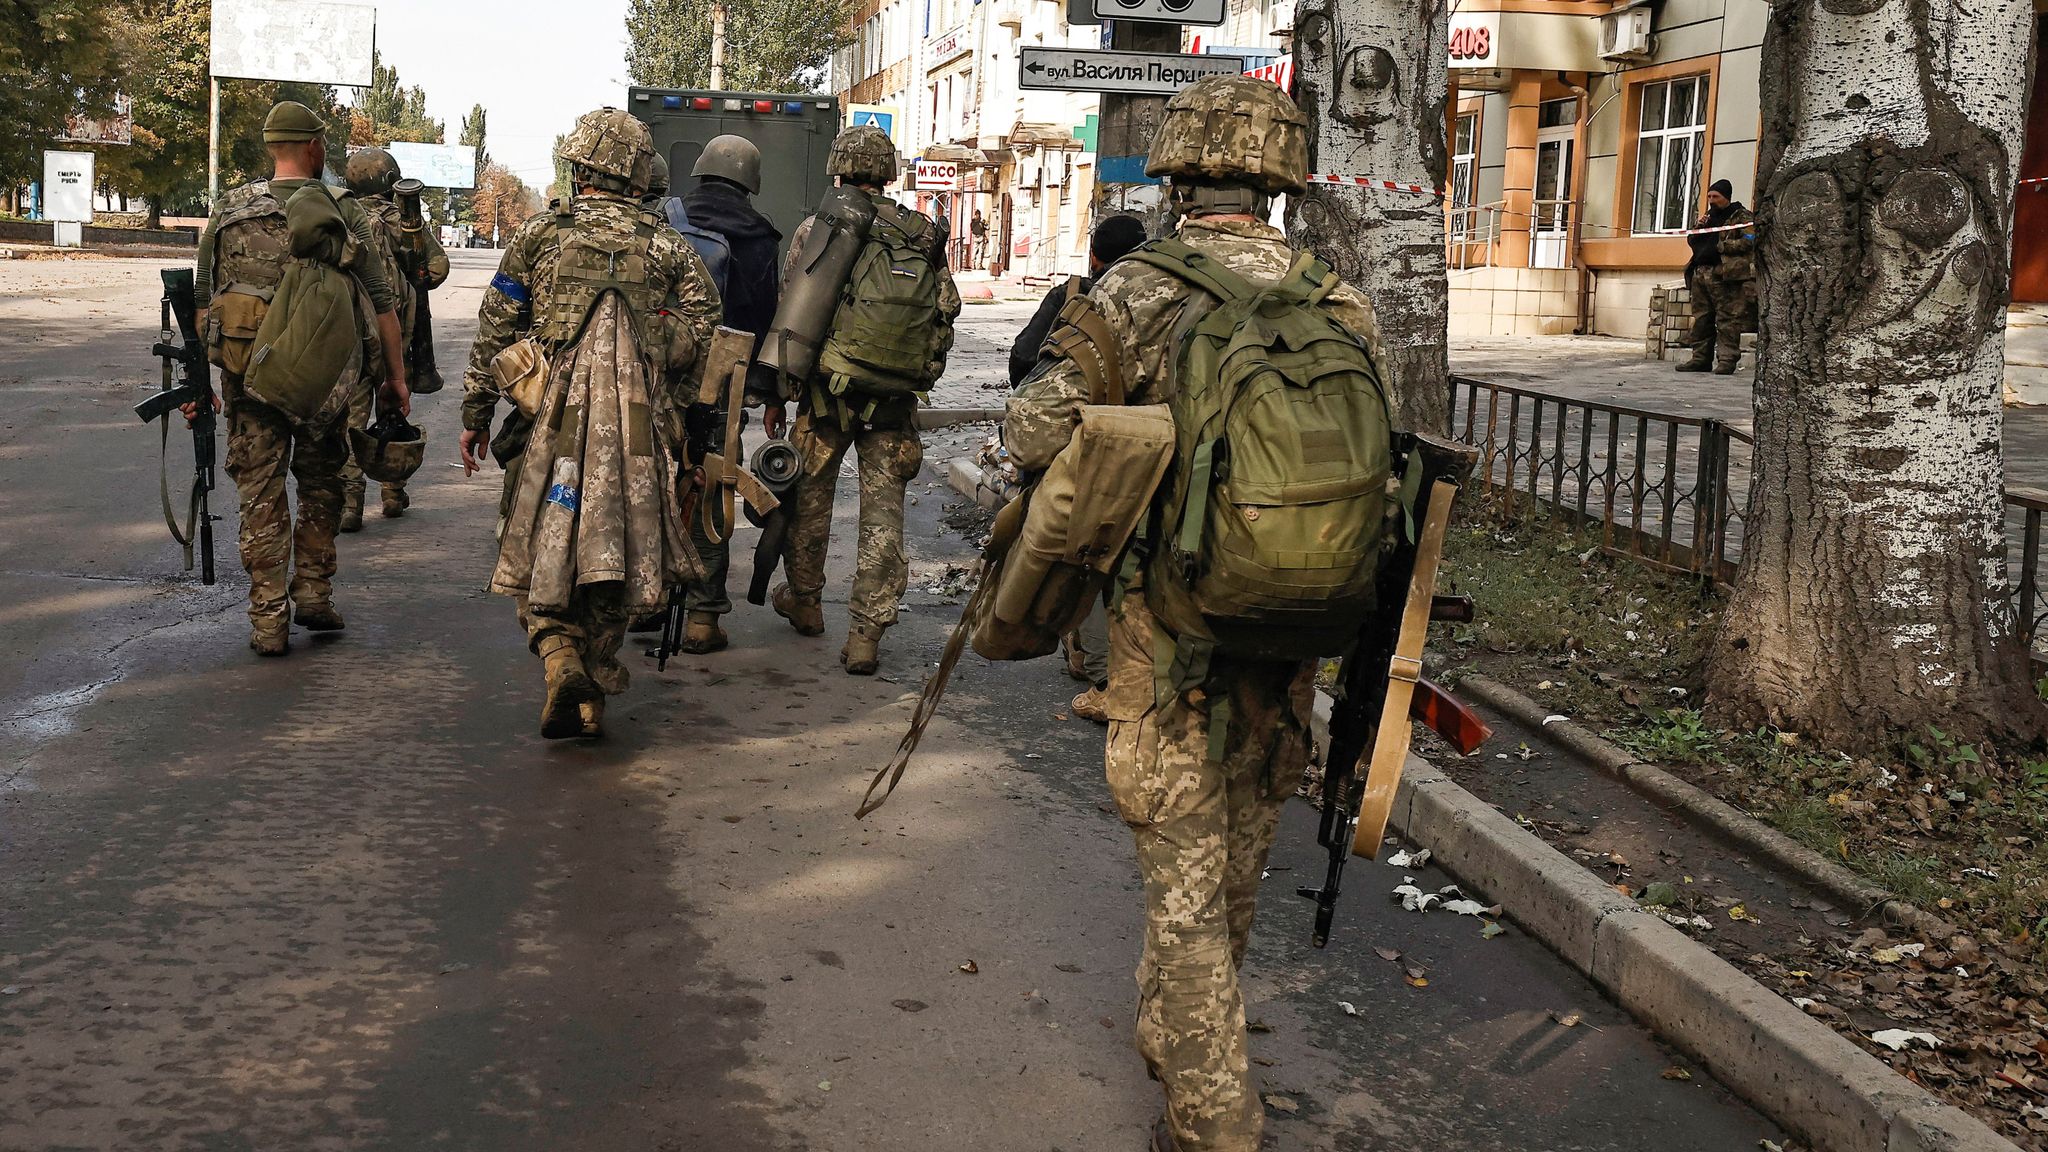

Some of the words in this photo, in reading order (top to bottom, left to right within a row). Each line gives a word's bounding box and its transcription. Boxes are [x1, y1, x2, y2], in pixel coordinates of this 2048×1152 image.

[1449, 27, 1490, 59] 408
[1047, 67, 1071, 79] вул.
[1073, 59, 1143, 81] Василя
[1148, 63, 1234, 87] Перш
[918, 165, 955, 177] М'ЯСО
